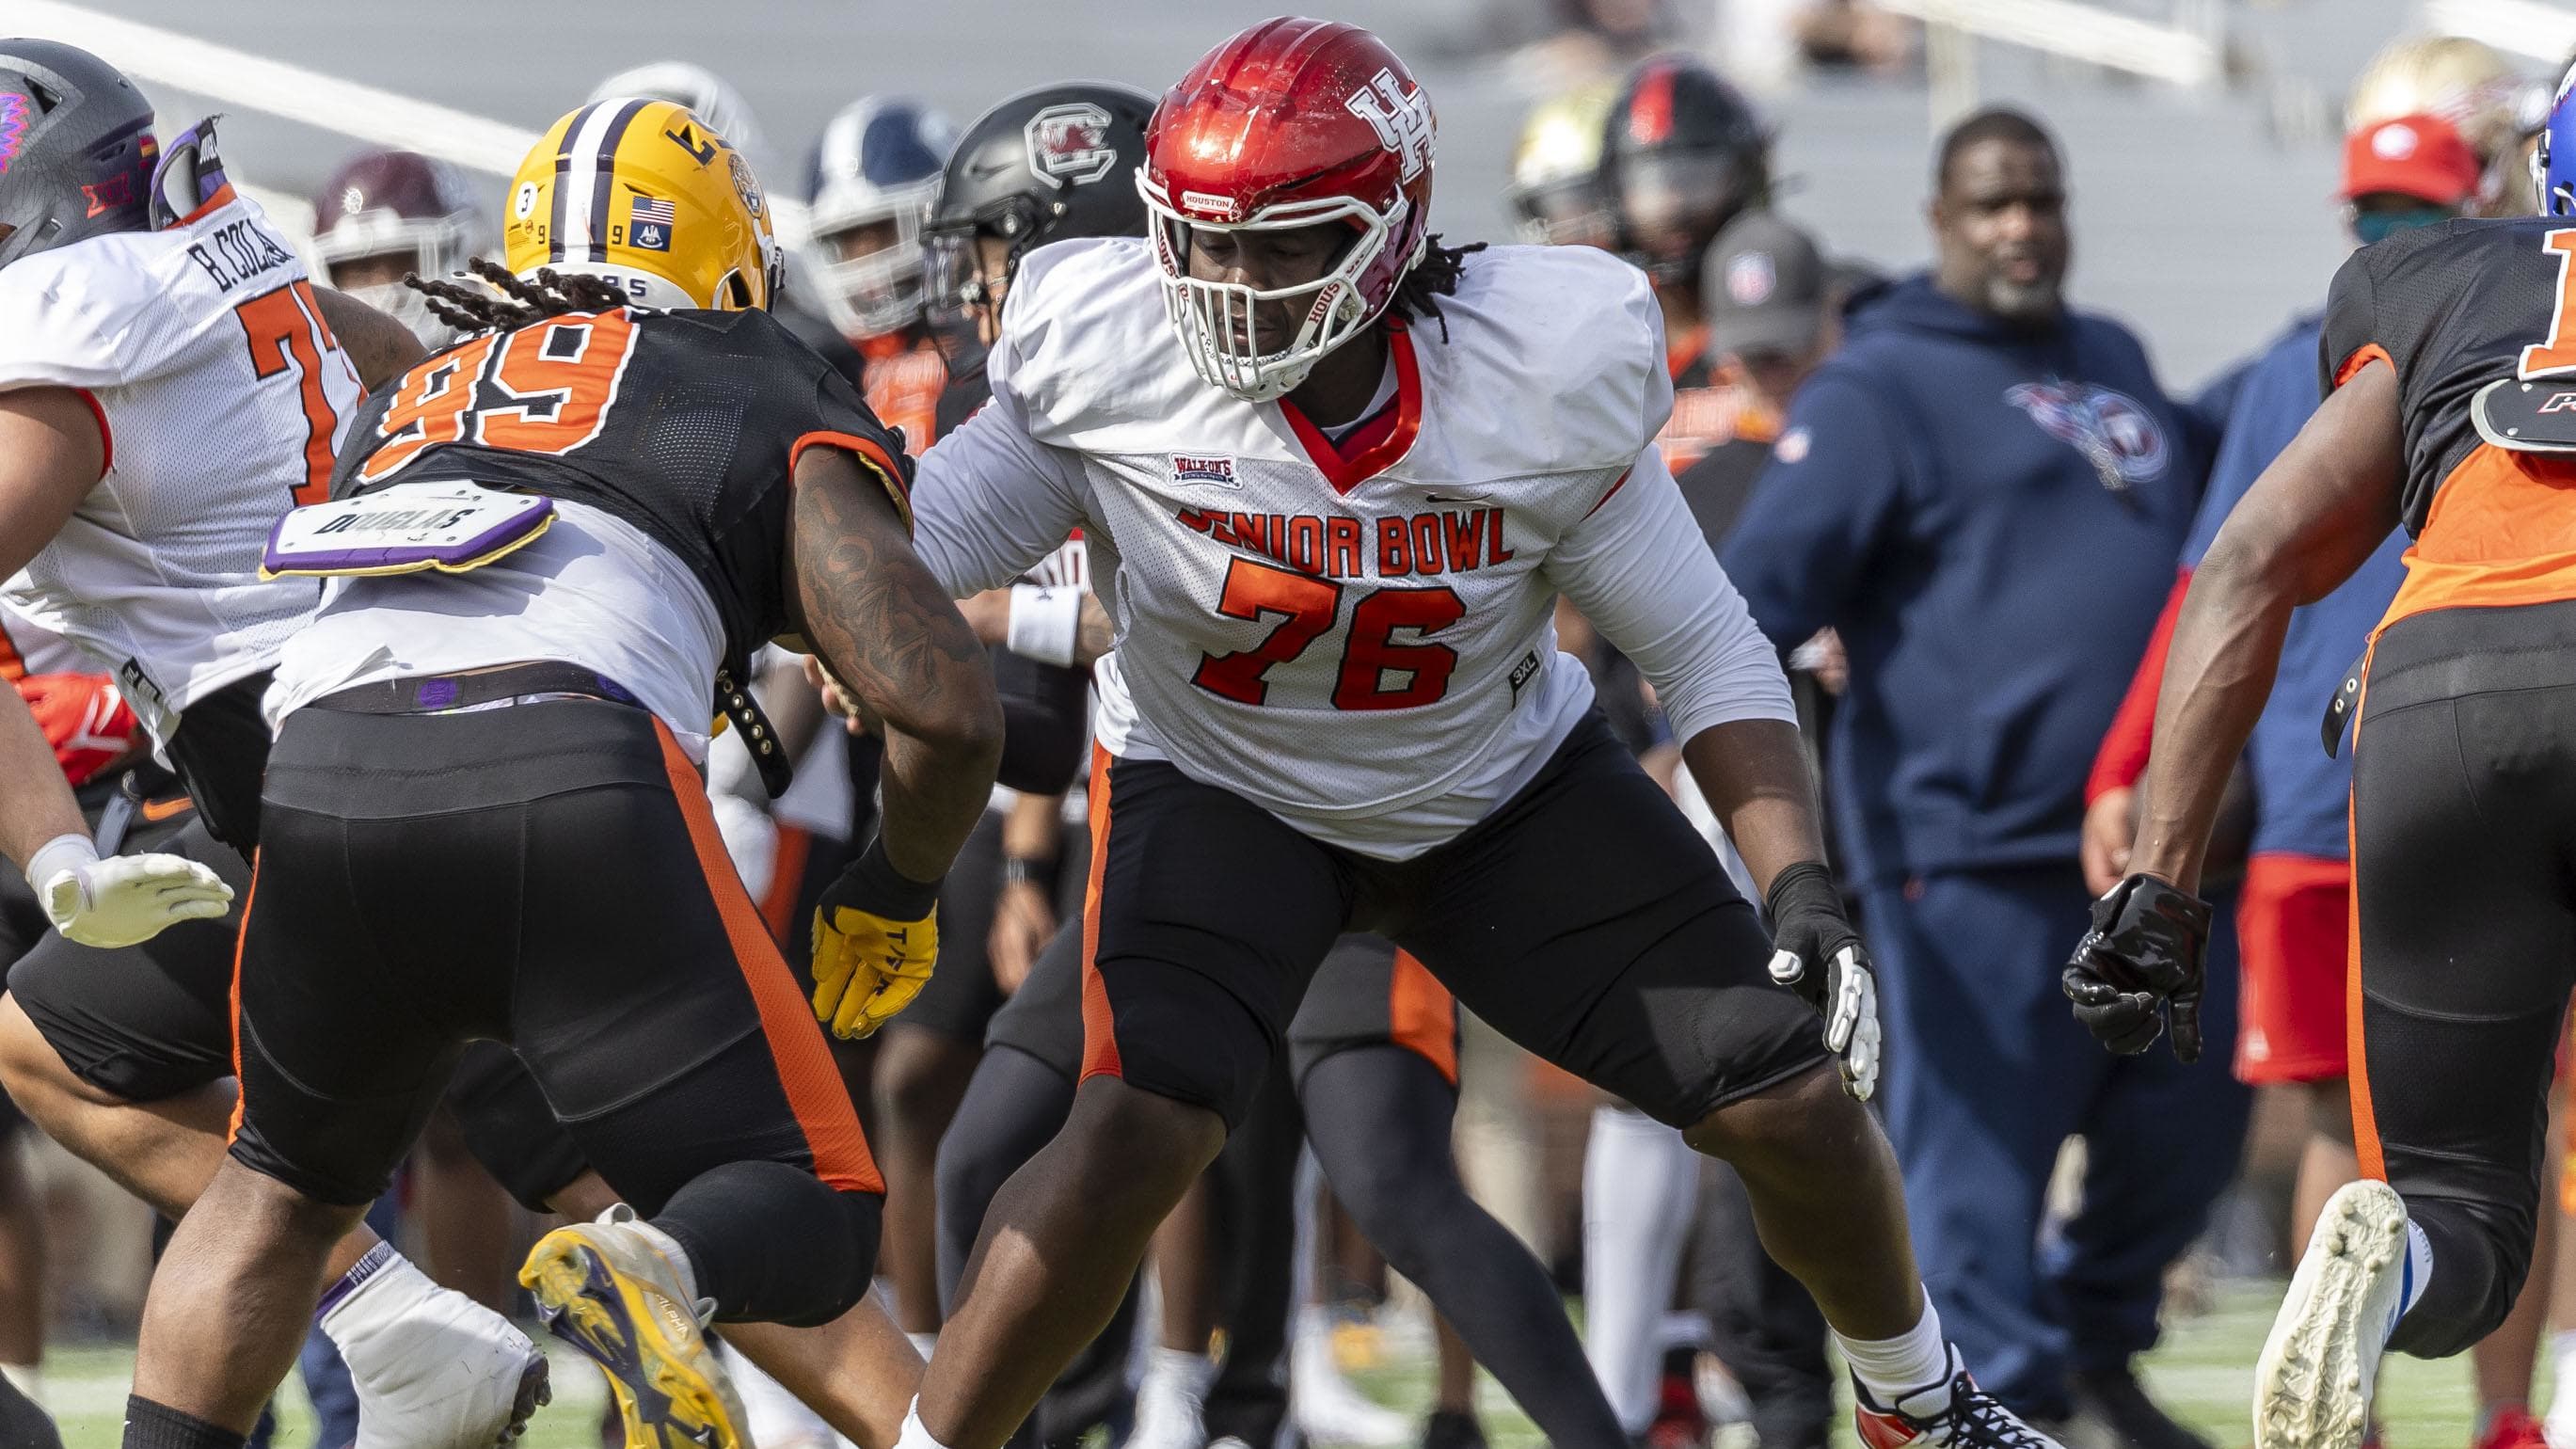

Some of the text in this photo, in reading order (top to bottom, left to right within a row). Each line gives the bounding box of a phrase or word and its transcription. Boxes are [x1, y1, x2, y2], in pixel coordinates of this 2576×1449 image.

[521, 188, 531, 213] 3
[1185, 195, 1230, 208] HOUSTON
[538, 225, 546, 245] 9
[612, 225, 623, 246] 9
[312, 508, 476, 535] DOUGLAS
[1375, 507, 1515, 577] BOWL
[1190, 554, 1467, 710] 76
[1513, 658, 1536, 685] 3XL
